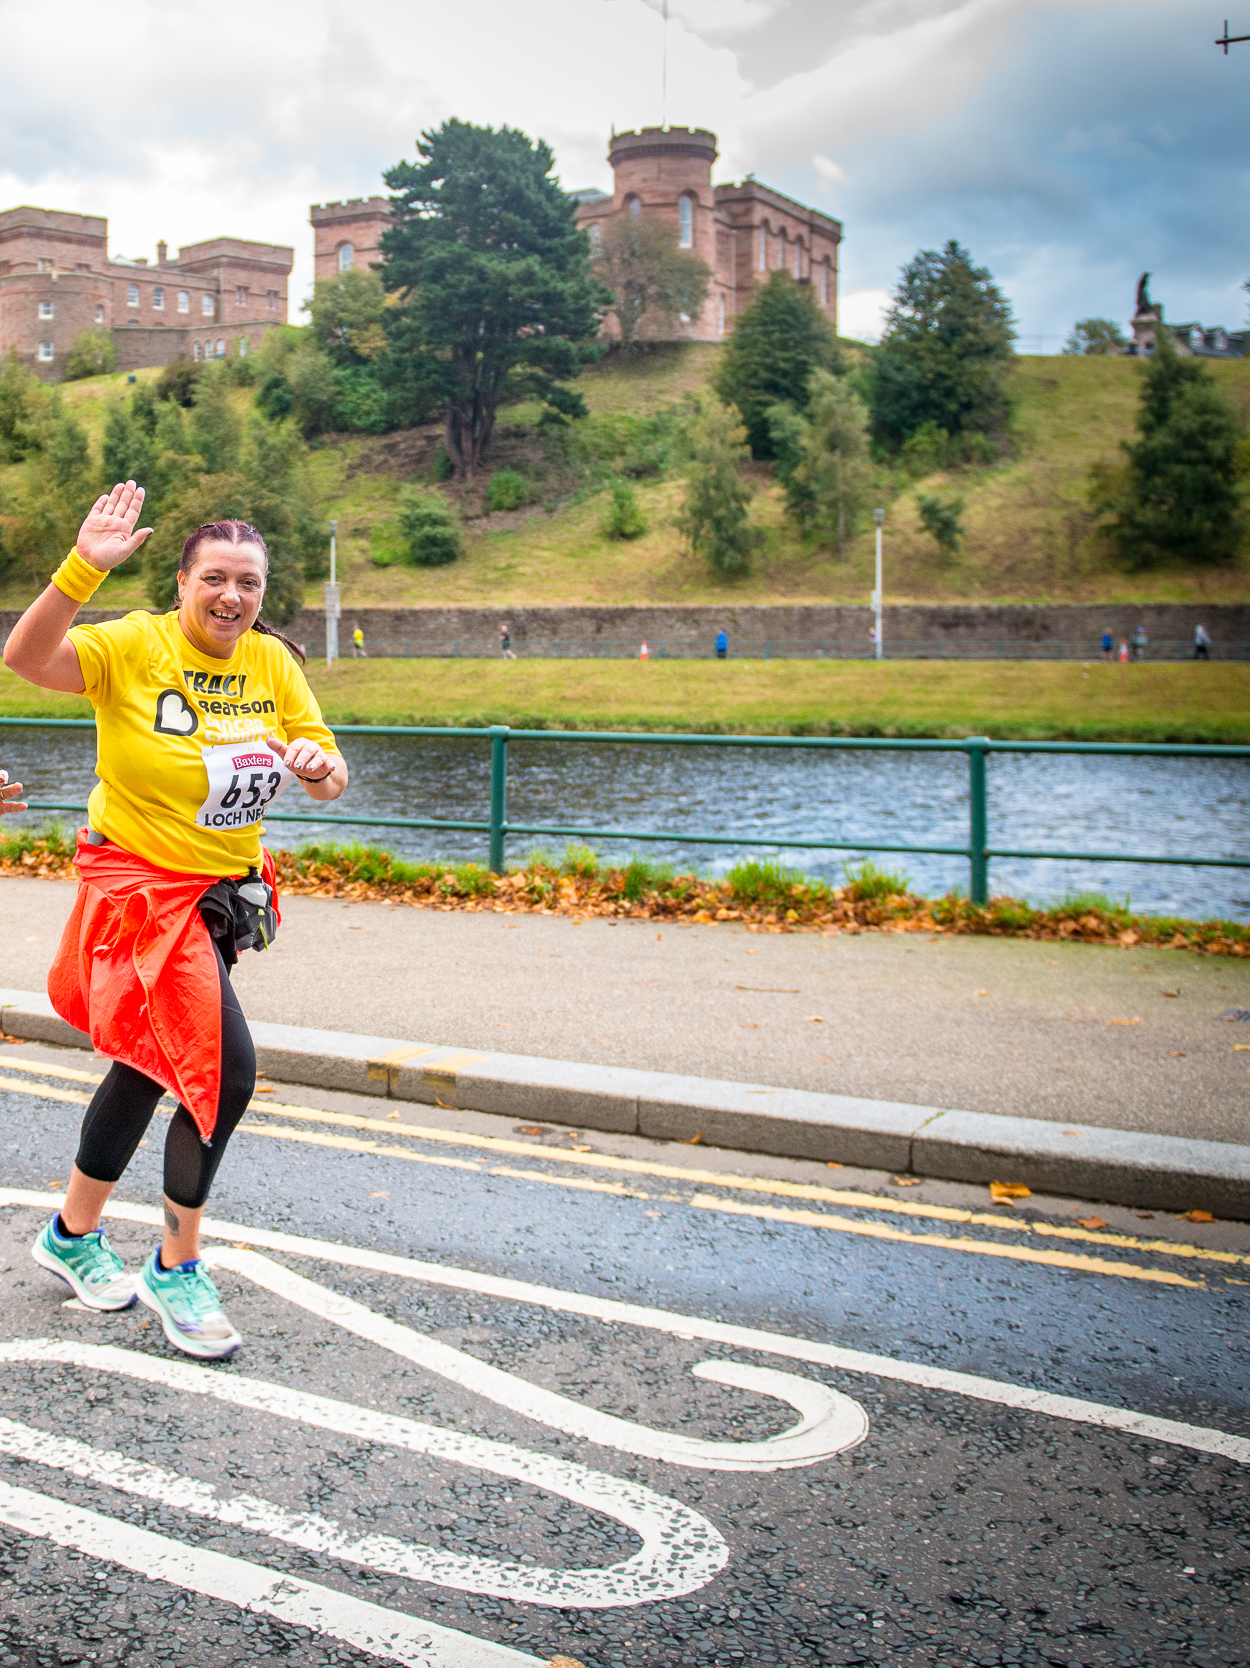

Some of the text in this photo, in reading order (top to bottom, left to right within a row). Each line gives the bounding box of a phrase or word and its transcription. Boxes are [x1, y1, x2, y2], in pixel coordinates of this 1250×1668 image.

[183, 670, 247, 698] TRACY
[234, 755, 272, 768] Baxters
[220, 771, 281, 809] 653
[204, 811, 242, 827] LOCH
